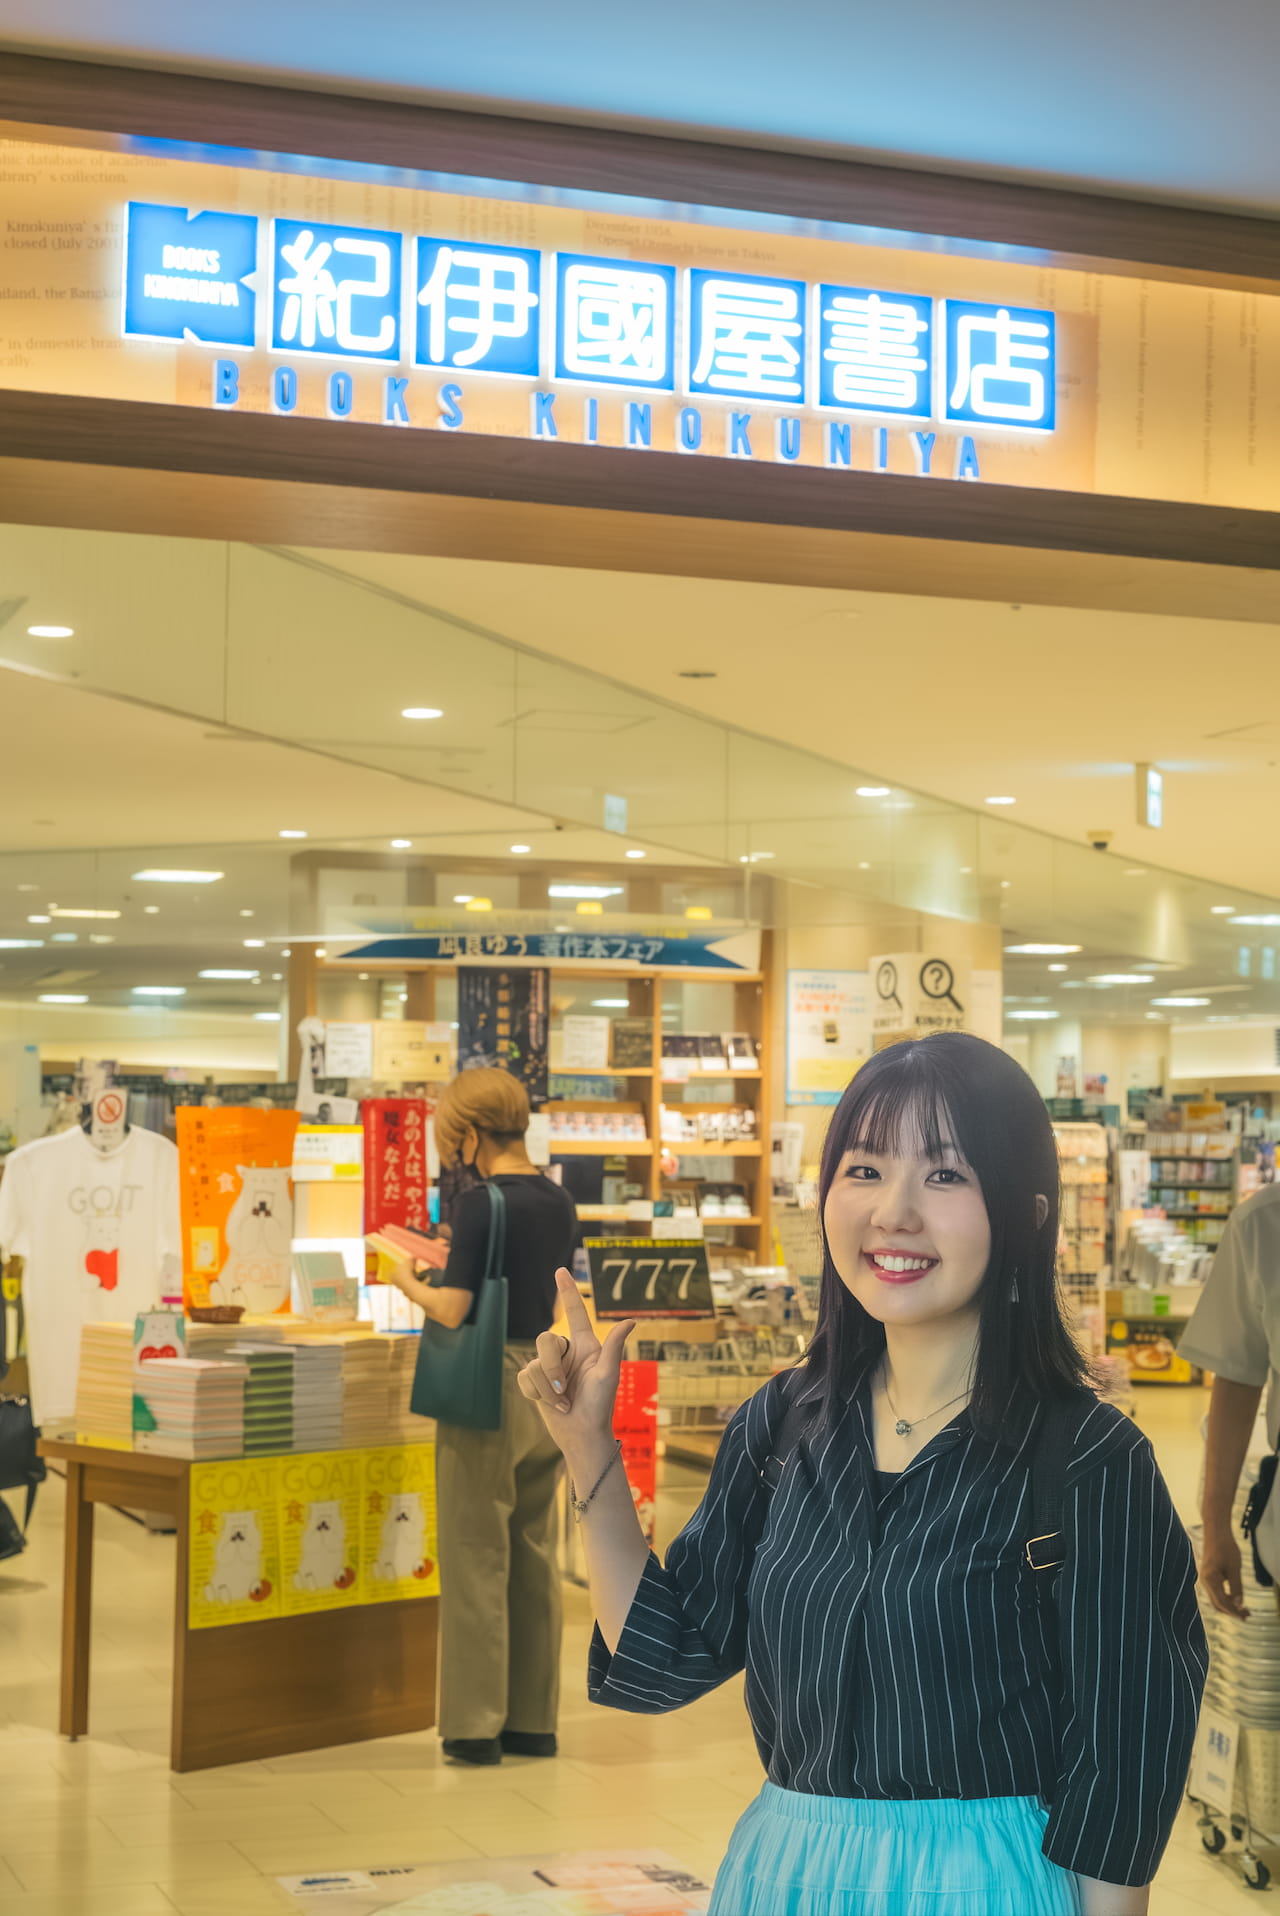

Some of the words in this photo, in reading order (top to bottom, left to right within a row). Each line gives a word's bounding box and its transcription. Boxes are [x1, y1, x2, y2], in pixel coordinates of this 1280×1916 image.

[162, 244, 220, 274] BOOKS
[278, 229, 1050, 420] 紀伊國屋書店
[213, 359, 464, 430] BOOKS
[532, 391, 981, 479] KINOKUNIYA
[601, 1258, 698, 1302] 777
[195, 1465, 278, 1504] GOAT
[282, 1457, 359, 1494] GOAT
